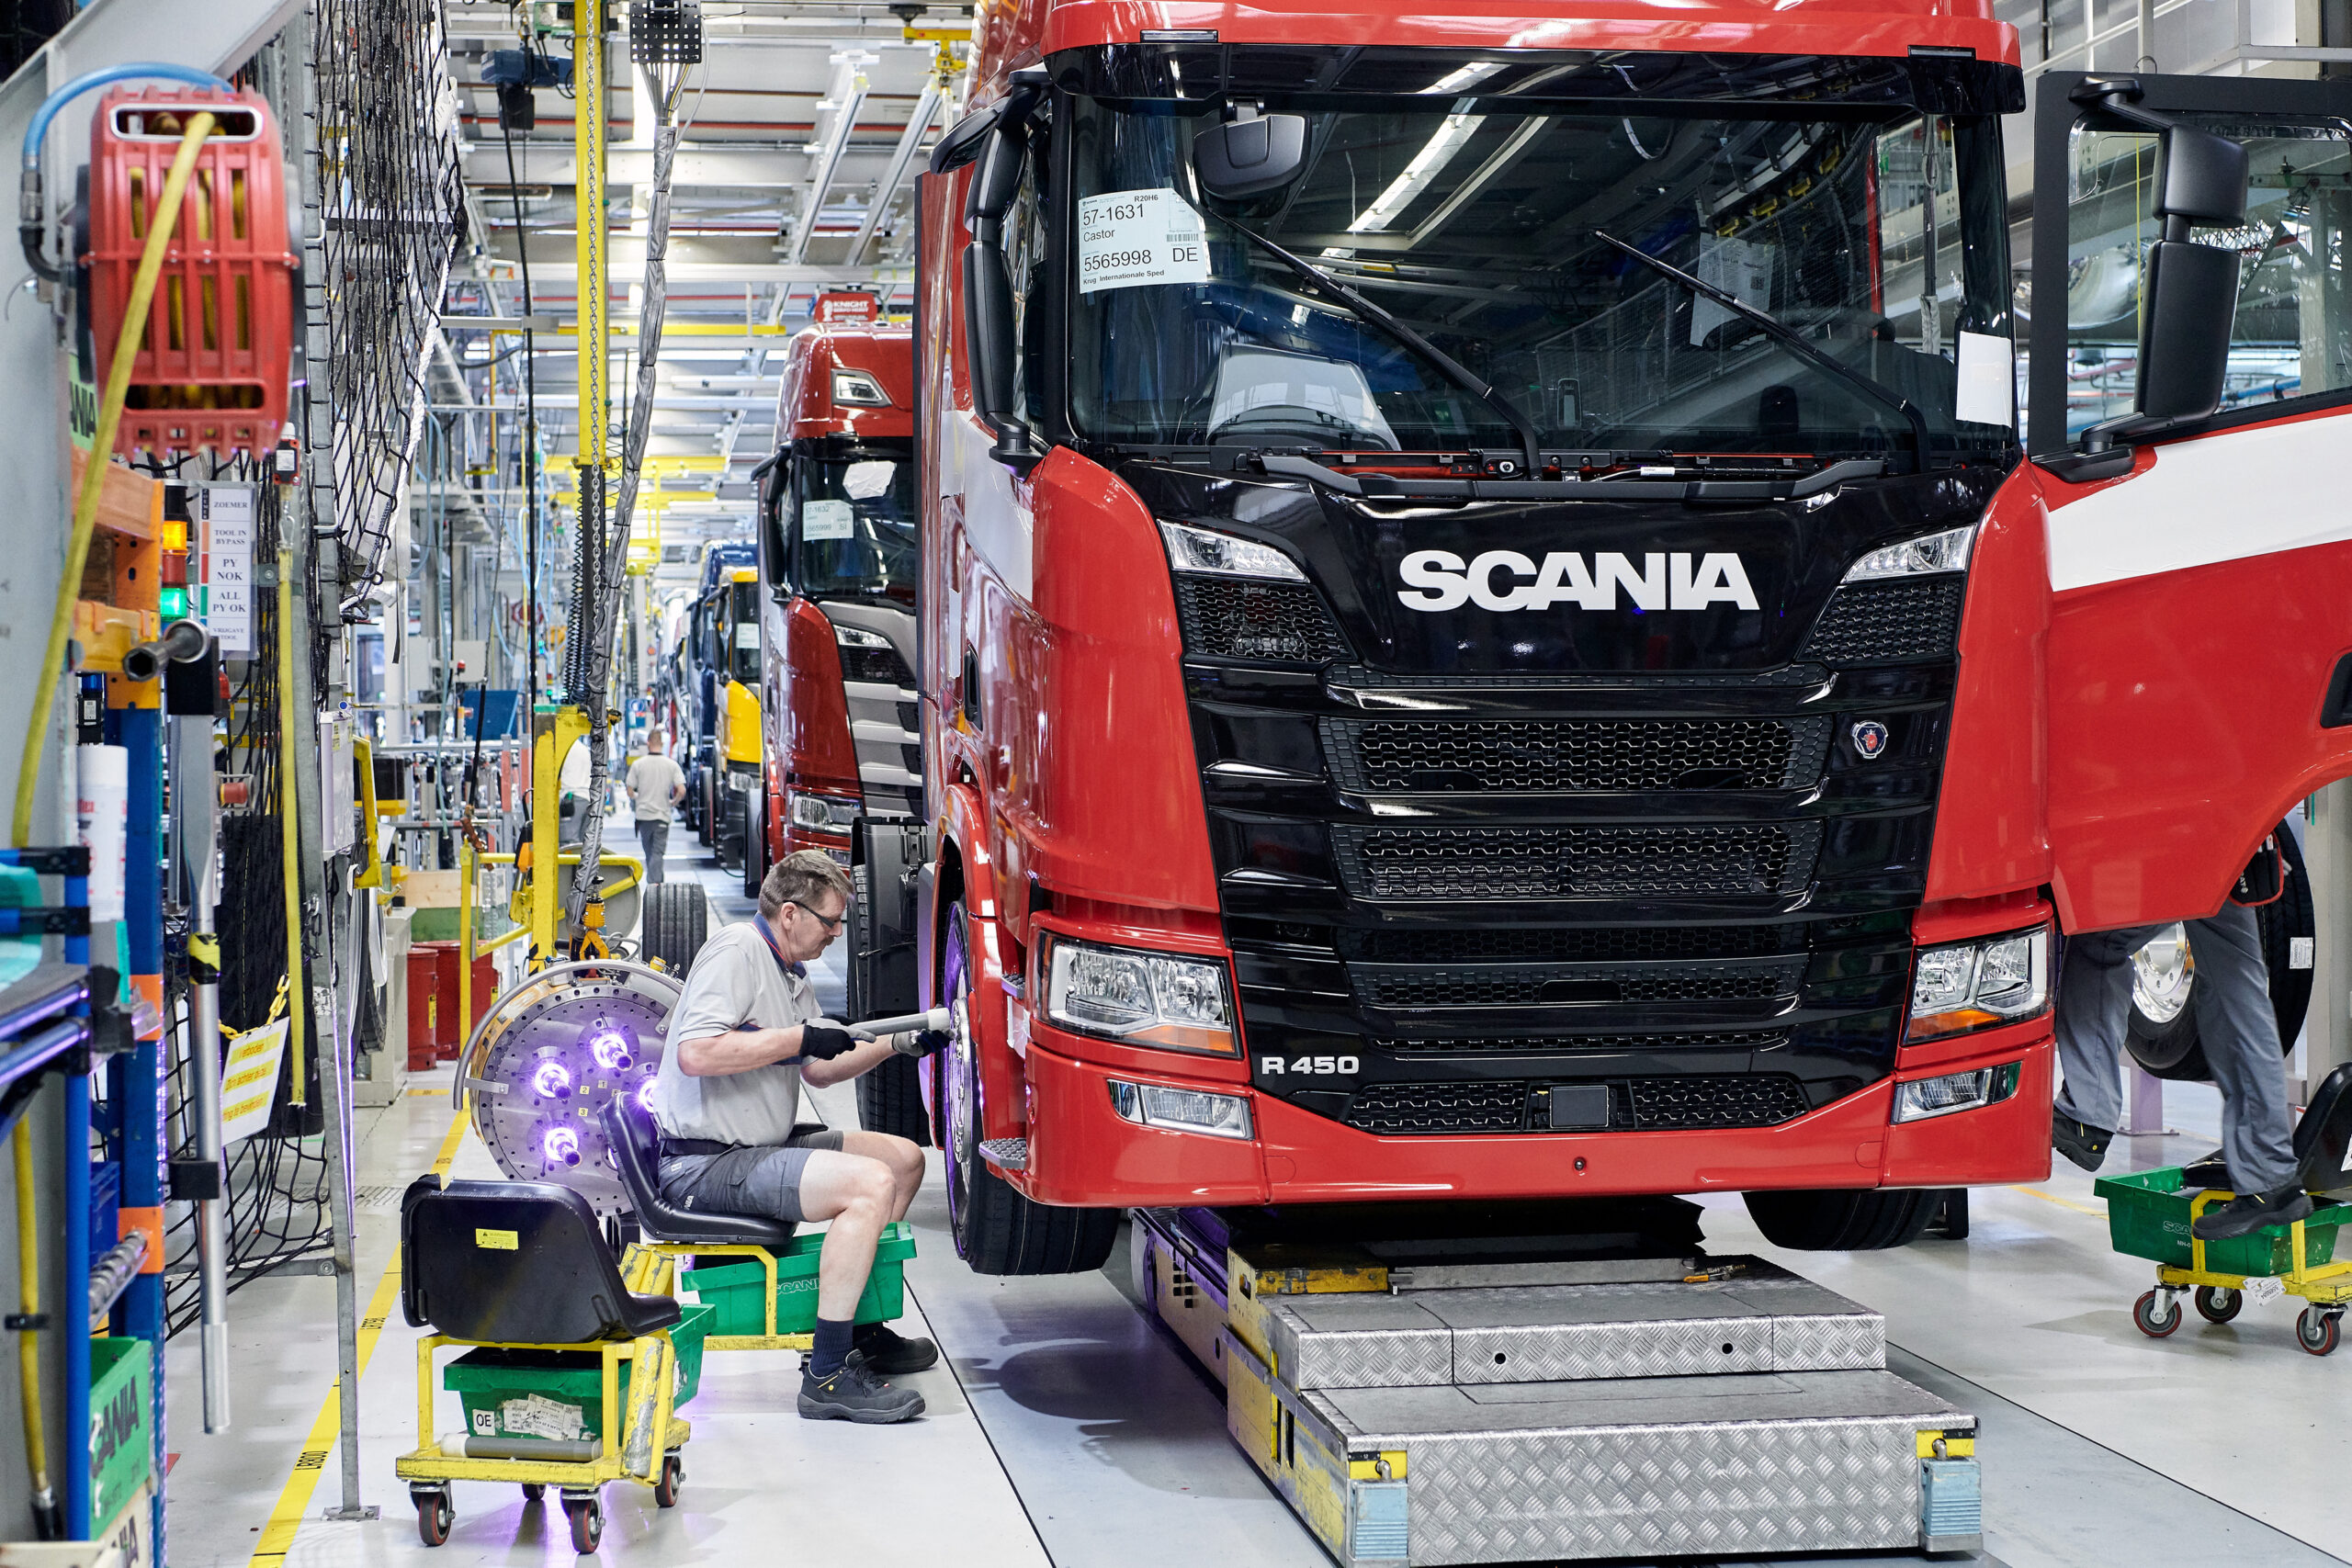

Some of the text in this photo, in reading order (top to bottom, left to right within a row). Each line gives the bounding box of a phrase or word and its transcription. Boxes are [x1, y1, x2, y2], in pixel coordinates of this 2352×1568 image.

[1083, 203, 1144, 226] 57-1631
[1083, 229, 1115, 243] Castor
[1084, 247, 1198, 272] 5565998 DE
[1099, 272, 1145, 282] Internationale
[1146, 269, 1165, 277] Sped
[222, 558, 236, 567] PY
[217, 571, 243, 581] NOK
[1397, 550, 1760, 612] SCANIA
[220, 592, 241, 600] ALL
[213, 604, 246, 613] PY OK
[1262, 1056, 1359, 1074] R 450
[476, 1413, 492, 1427] OE
